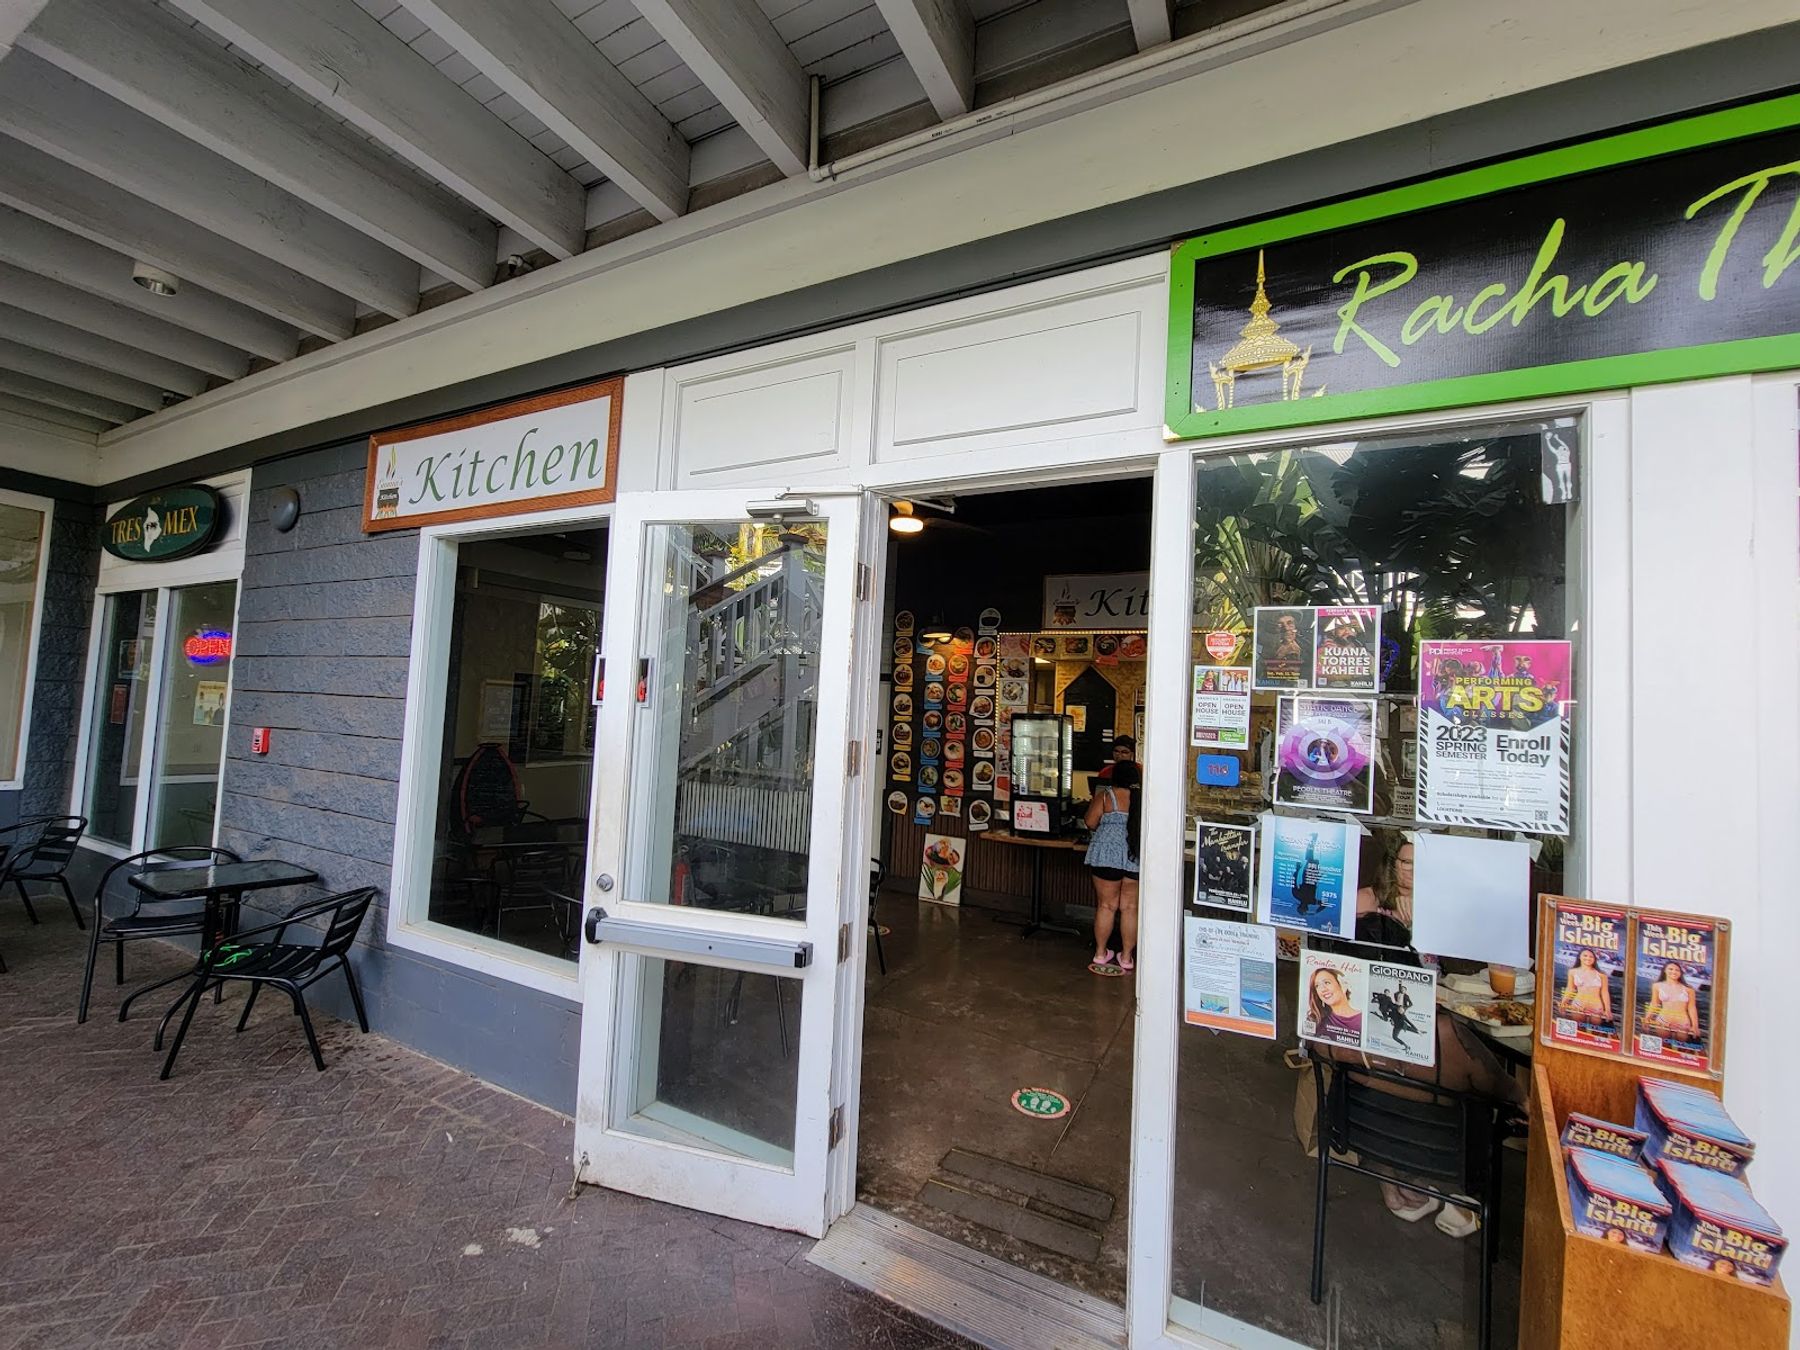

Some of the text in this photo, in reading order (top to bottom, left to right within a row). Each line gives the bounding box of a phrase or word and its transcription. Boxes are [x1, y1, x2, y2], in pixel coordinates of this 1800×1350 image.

[1332, 218, 1659, 368] Racha
[408, 427, 602, 505] Kitchen
[112, 505, 198, 544] TRES MEX
[185, 638, 232, 656] OPEN
[1324, 647, 1368, 656] KUANA
[1321, 656, 1371, 666] TORRES
[1321, 666, 1370, 675] KAHELE
[1455, 677, 1532, 686] PERFORMING
[1198, 701, 1217, 709] OPEN
[1446, 685, 1543, 712] ARTS
[1462, 710, 1525, 719] CLASSES
[1436, 725, 1488, 742] 2023
[1496, 734, 1551, 751] Enroll
[1435, 741, 1487, 753] SPRING
[1435, 751, 1487, 760] SEMESTER
[1496, 749, 1550, 767] Today
[1201, 830, 1242, 848] Manhattan
[1562, 912, 1578, 920] This
[1582, 914, 1614, 938] Big
[1647, 924, 1663, 932] This
[1559, 924, 1619, 951] Island
[1667, 926, 1702, 951] Big
[1643, 937, 1706, 964] Island
[1372, 965, 1430, 982] GIORDANO
[1567, 1131, 1633, 1155] Island
[1594, 1128, 1630, 1147] Big
[1663, 1140, 1738, 1172] Island
[1695, 1140, 1735, 1164] Big
[1586, 1203, 1658, 1236] Island
[1614, 1201, 1653, 1227] Big
[1692, 1230, 1773, 1270] Island
[1726, 1229, 1769, 1257] Big
